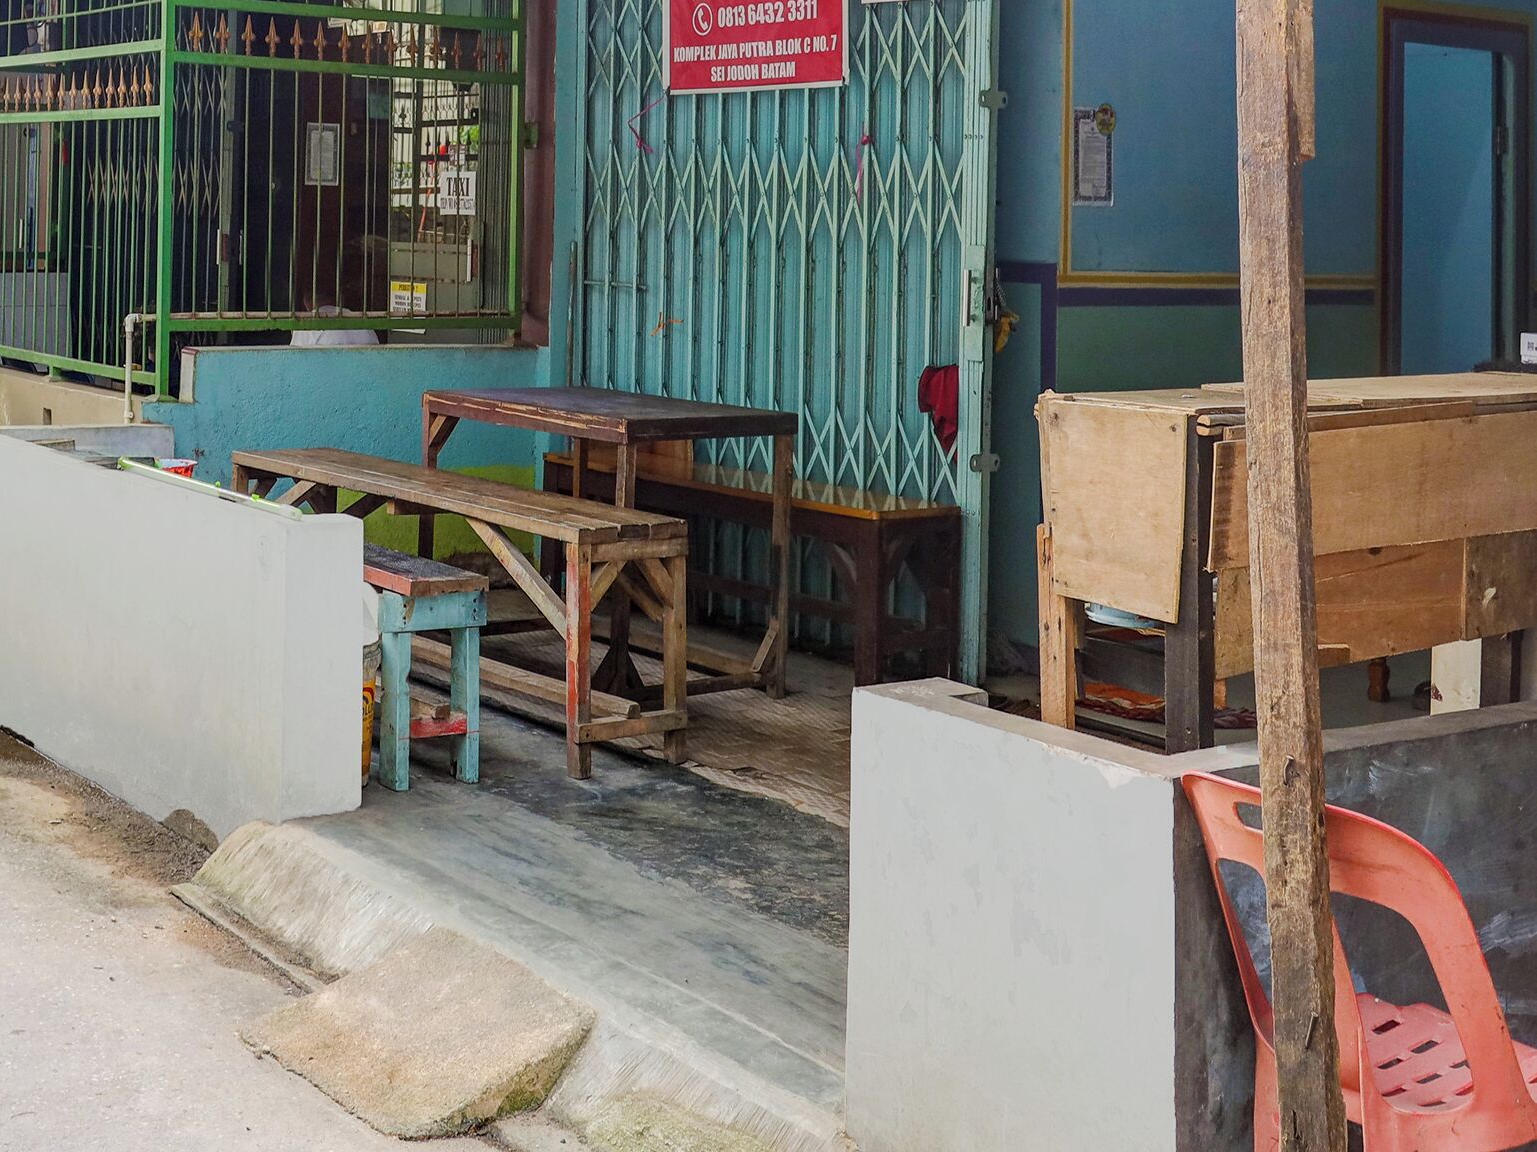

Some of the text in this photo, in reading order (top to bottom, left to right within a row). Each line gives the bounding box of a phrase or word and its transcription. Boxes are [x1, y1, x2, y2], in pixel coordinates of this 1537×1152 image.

[717, 4, 746, 28] 0813
[747, 0, 784, 26] 6432
[674, 34, 838, 63] KOMPLEK JAYA PUTRA BLOK C NO. 7
[711, 61, 796, 82] SEI JODOH BATAM
[447, 177, 470, 196] TAXI
